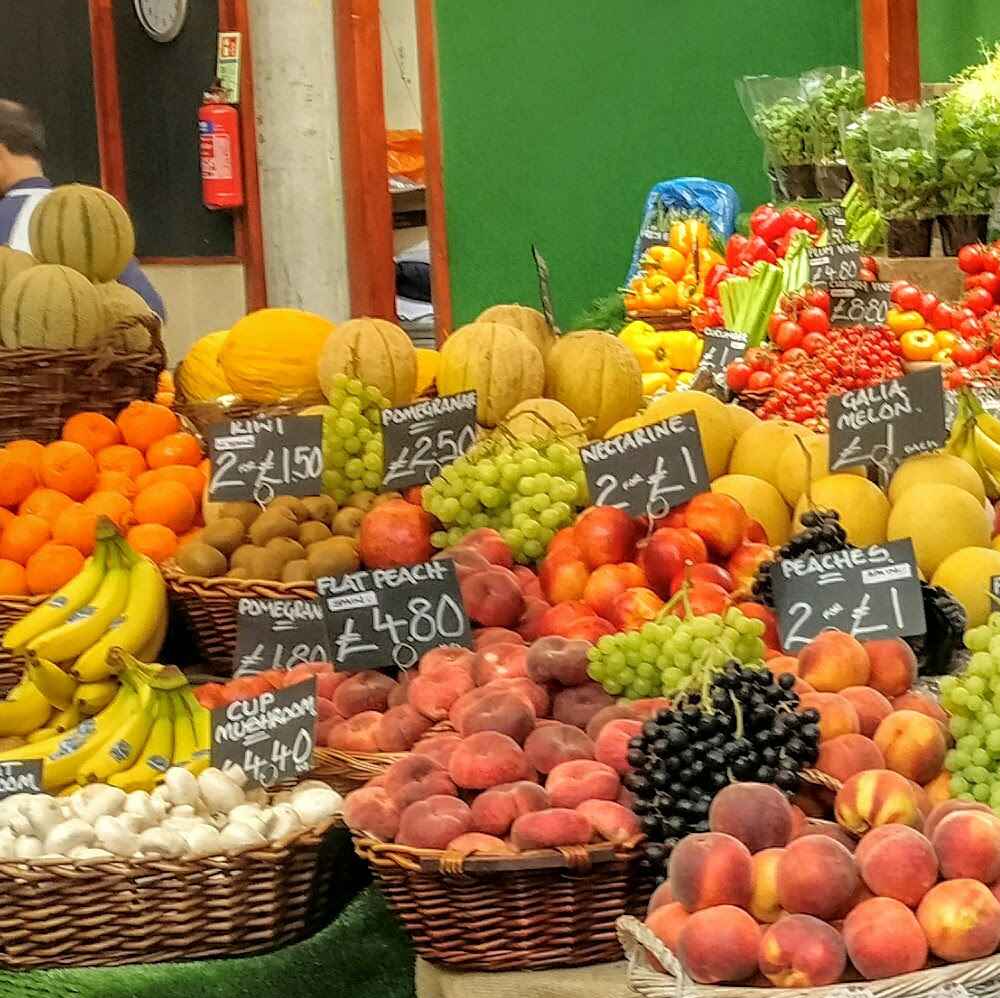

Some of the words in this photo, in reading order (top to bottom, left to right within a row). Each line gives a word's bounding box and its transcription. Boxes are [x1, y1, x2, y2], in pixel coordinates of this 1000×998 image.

[842, 380, 908, 411] GALIA
[230, 416, 284, 435] KIWI
[208, 451, 245, 494] 2
[595, 474, 630, 508] 2
[316, 571, 370, 596] FLAT
[373, 561, 449, 590] PEACH
[335, 594, 465, 663] £4.80
[784, 601, 815, 650] 2
[850, 586, 905, 636] £1
[226, 692, 276, 722] CUP
